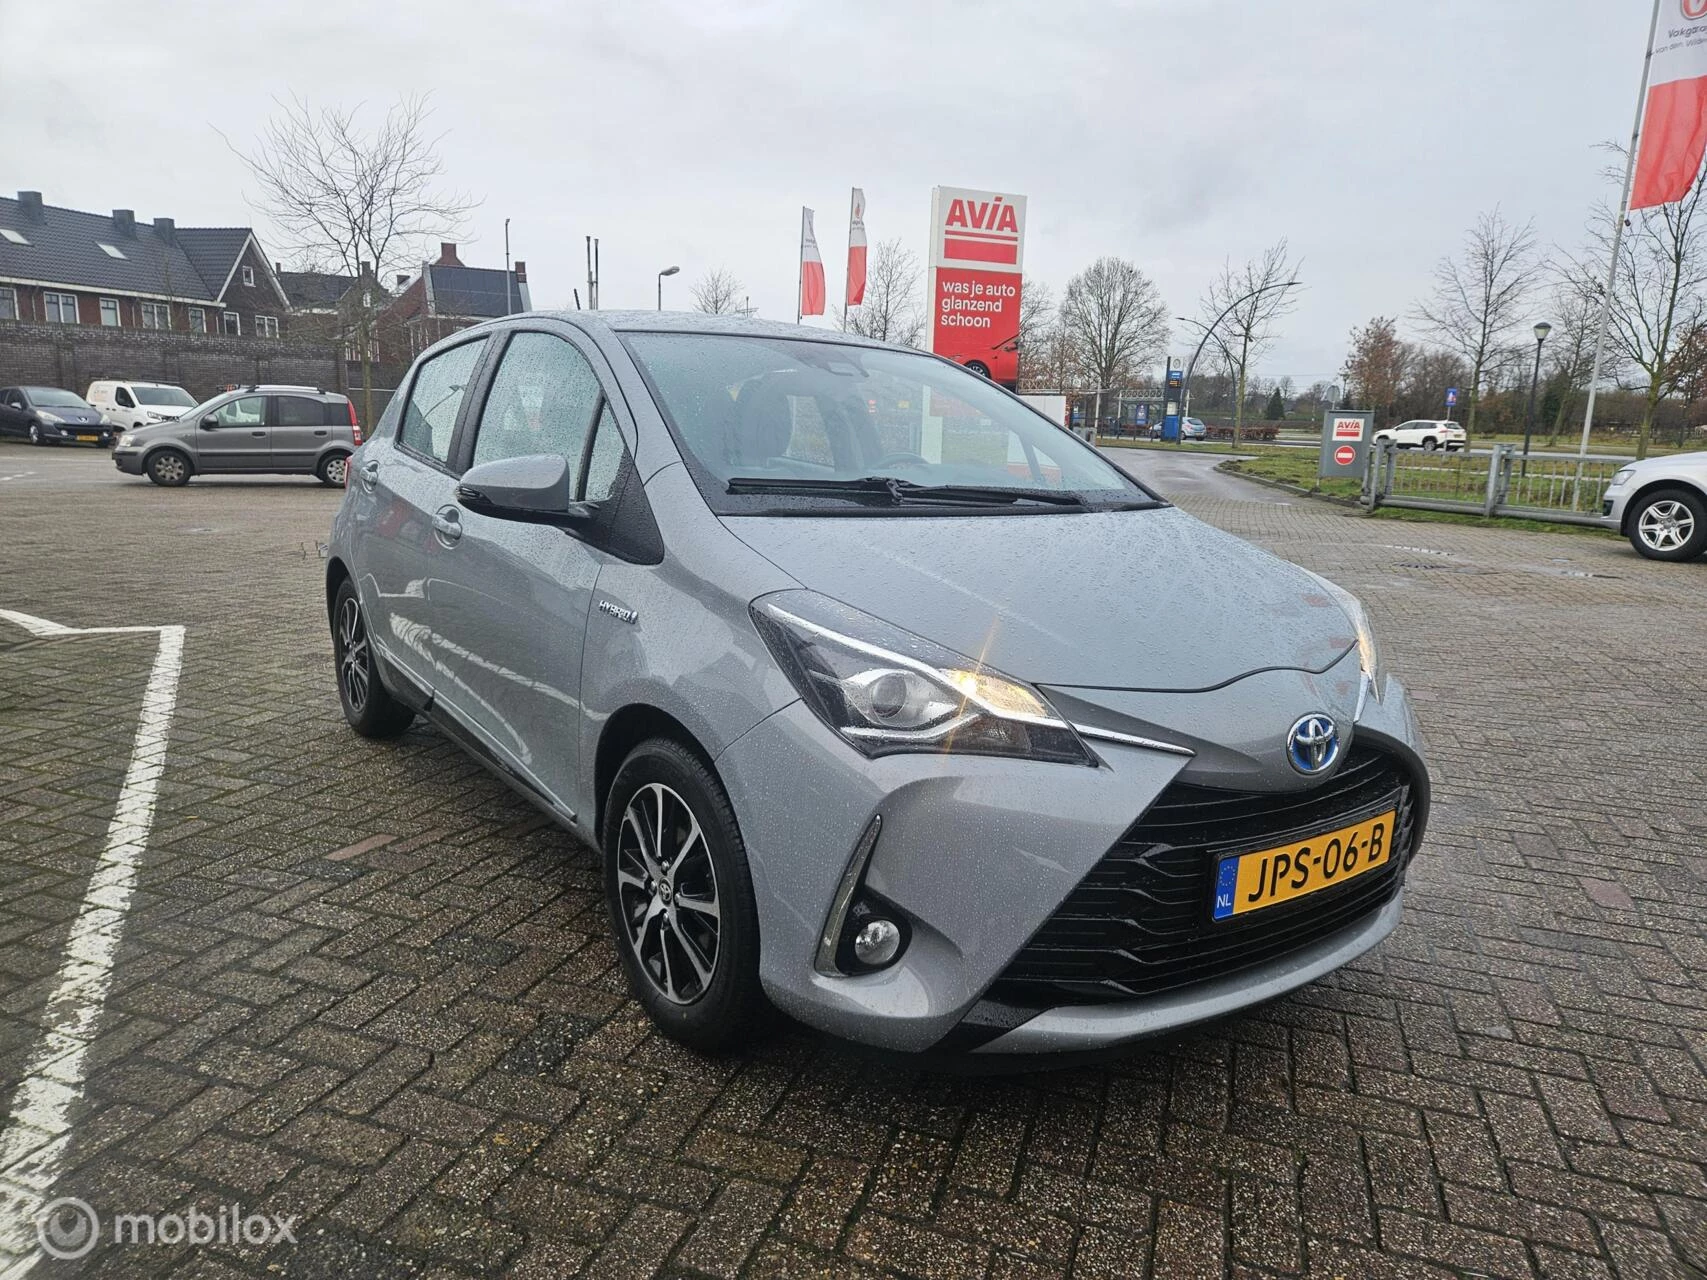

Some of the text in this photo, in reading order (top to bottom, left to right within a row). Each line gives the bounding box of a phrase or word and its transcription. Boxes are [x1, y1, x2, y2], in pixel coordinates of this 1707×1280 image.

[1668, 25, 1707, 38] Vakgara
[942, 280, 1016, 298] was je auto
[941, 295, 1003, 313] glanzend
[940, 312, 991, 328] schoon
[1216, 822, 1385, 909] NL JPS-06-B
